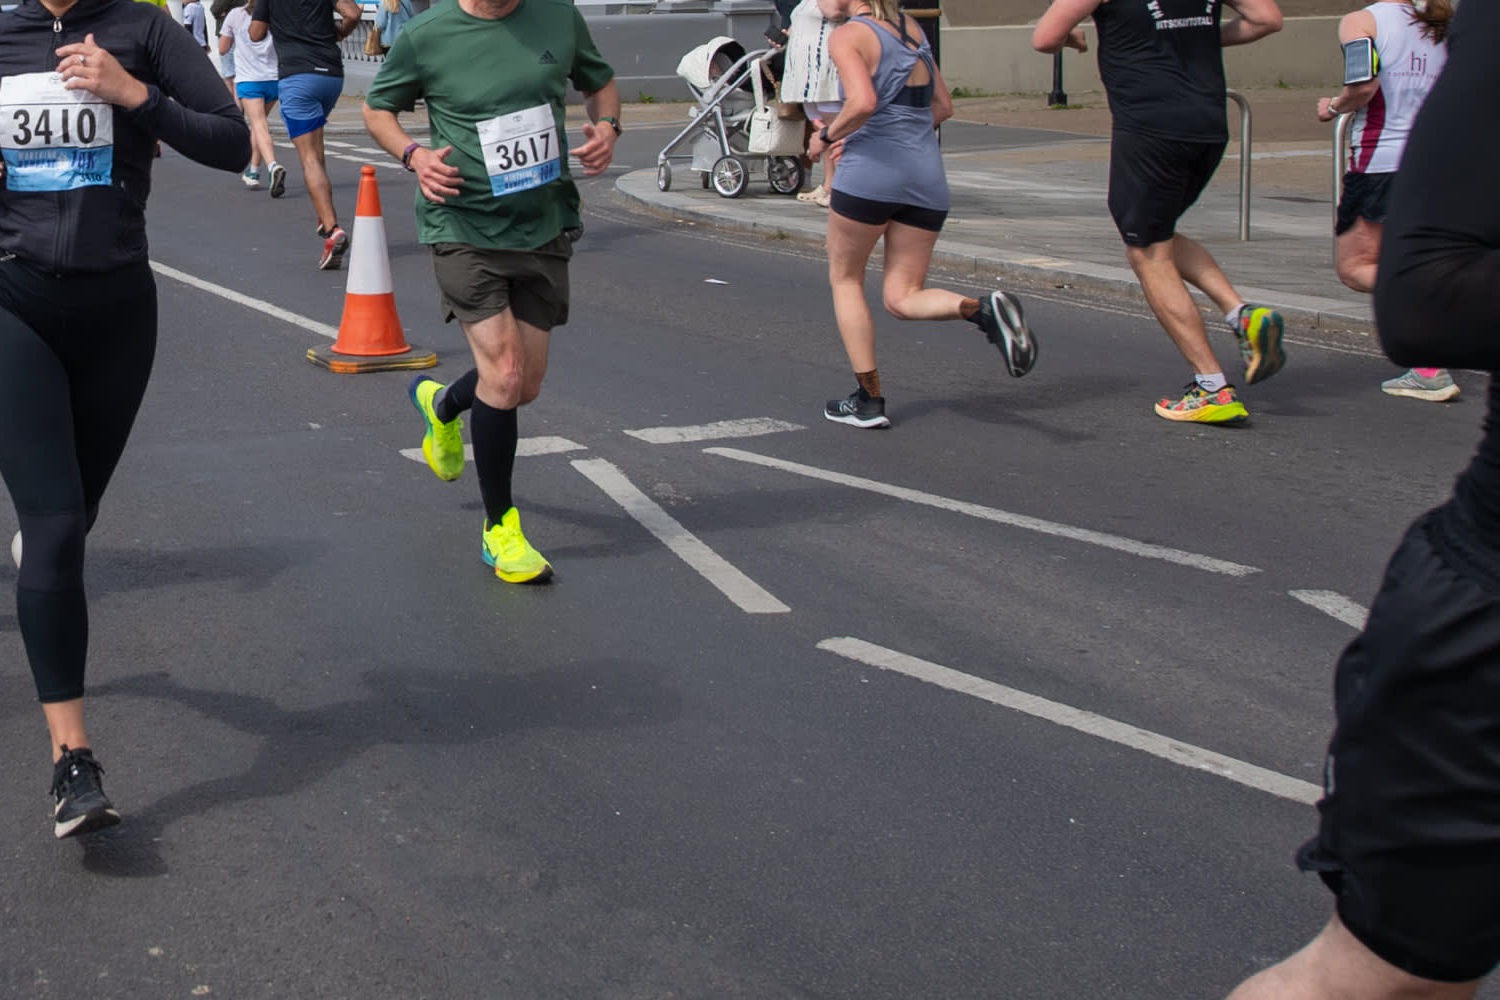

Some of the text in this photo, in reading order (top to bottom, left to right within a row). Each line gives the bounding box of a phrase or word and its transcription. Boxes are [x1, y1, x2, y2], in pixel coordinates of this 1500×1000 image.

[1411, 51, 1427, 75] hj
[13, 108, 97, 146] 3410
[71, 150, 97, 169] 10K
[496, 132, 550, 170] 3617
